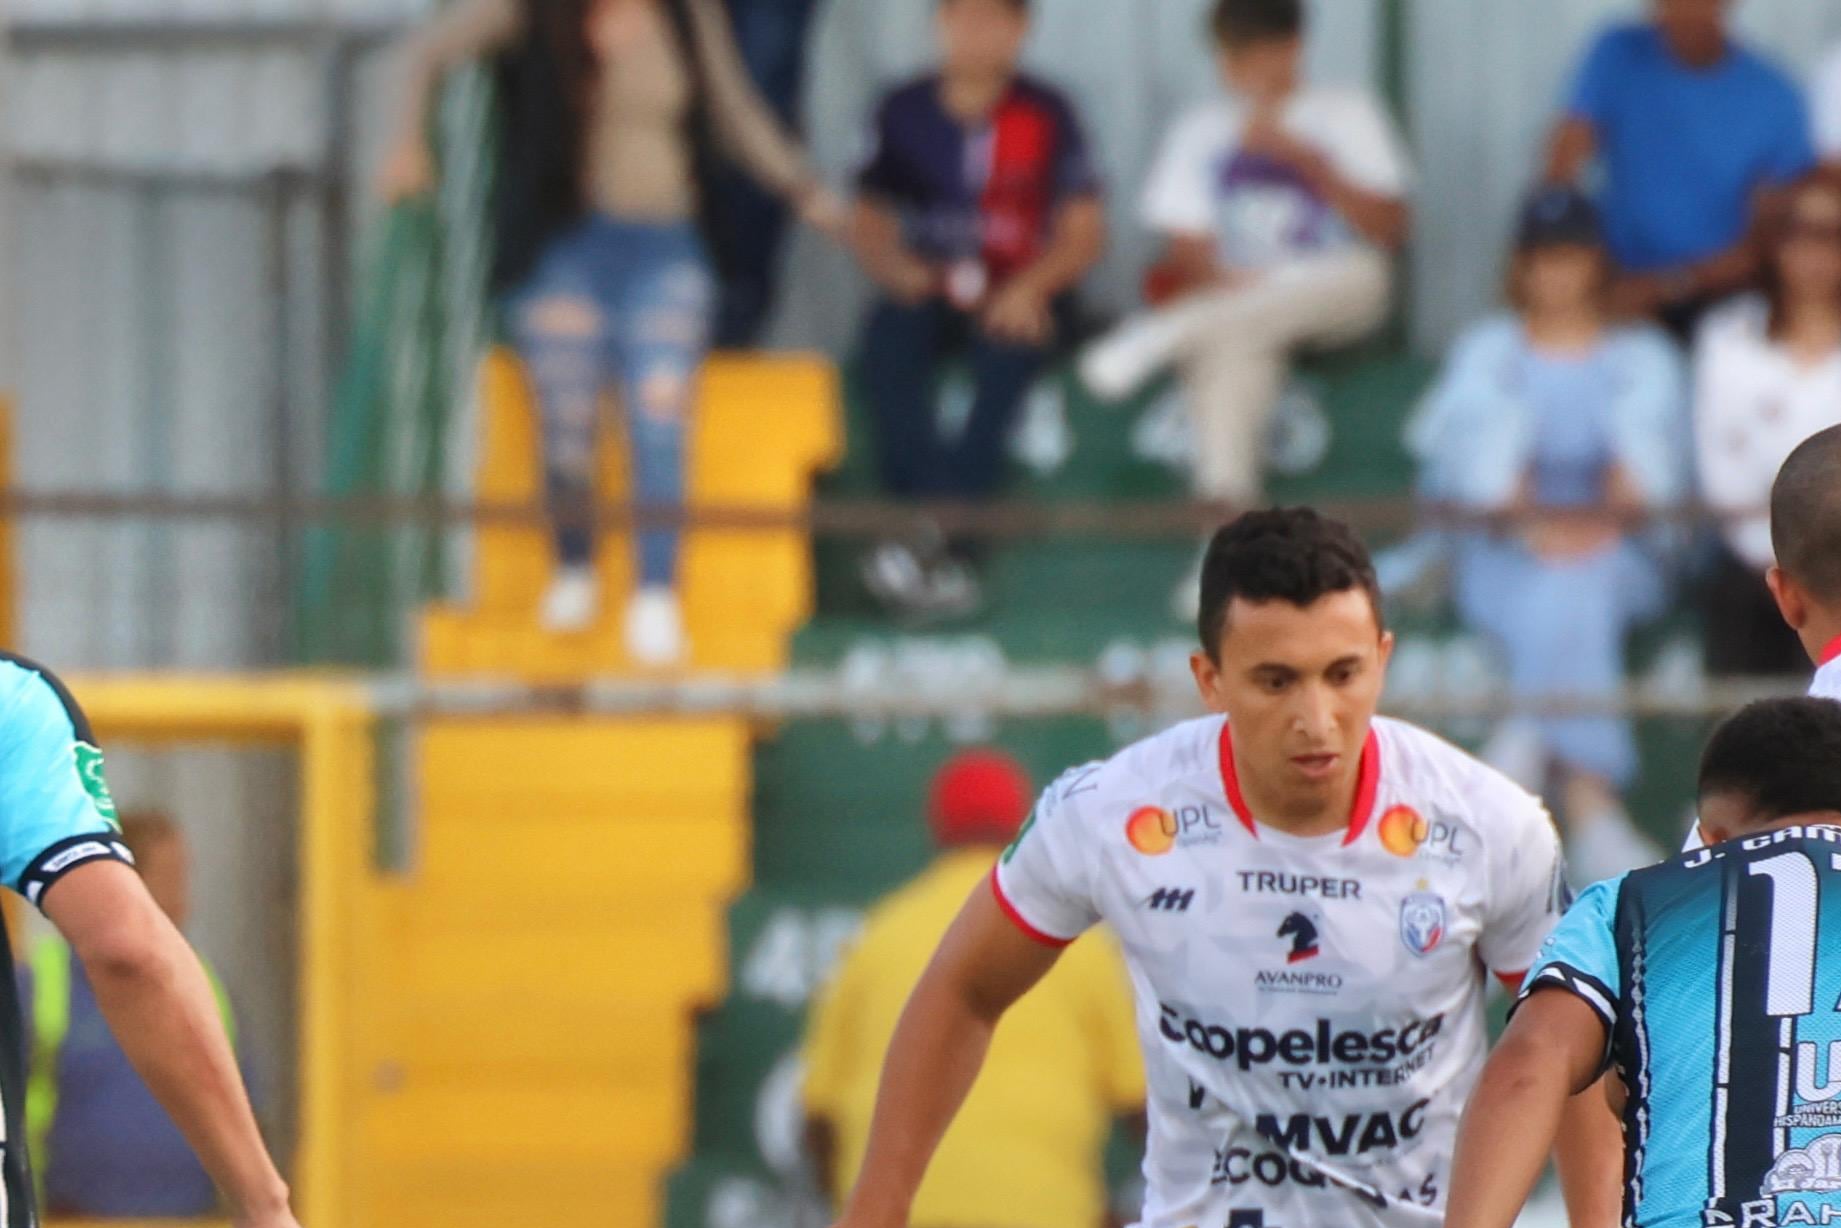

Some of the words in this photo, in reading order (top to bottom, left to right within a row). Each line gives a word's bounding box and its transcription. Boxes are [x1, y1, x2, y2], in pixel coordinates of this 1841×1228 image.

[1159, 804, 1222, 838] UPL
[1412, 815, 1462, 856] UPL
[1237, 870, 1362, 900] TRUPER
[1255, 969, 1343, 989] AVANPRO
